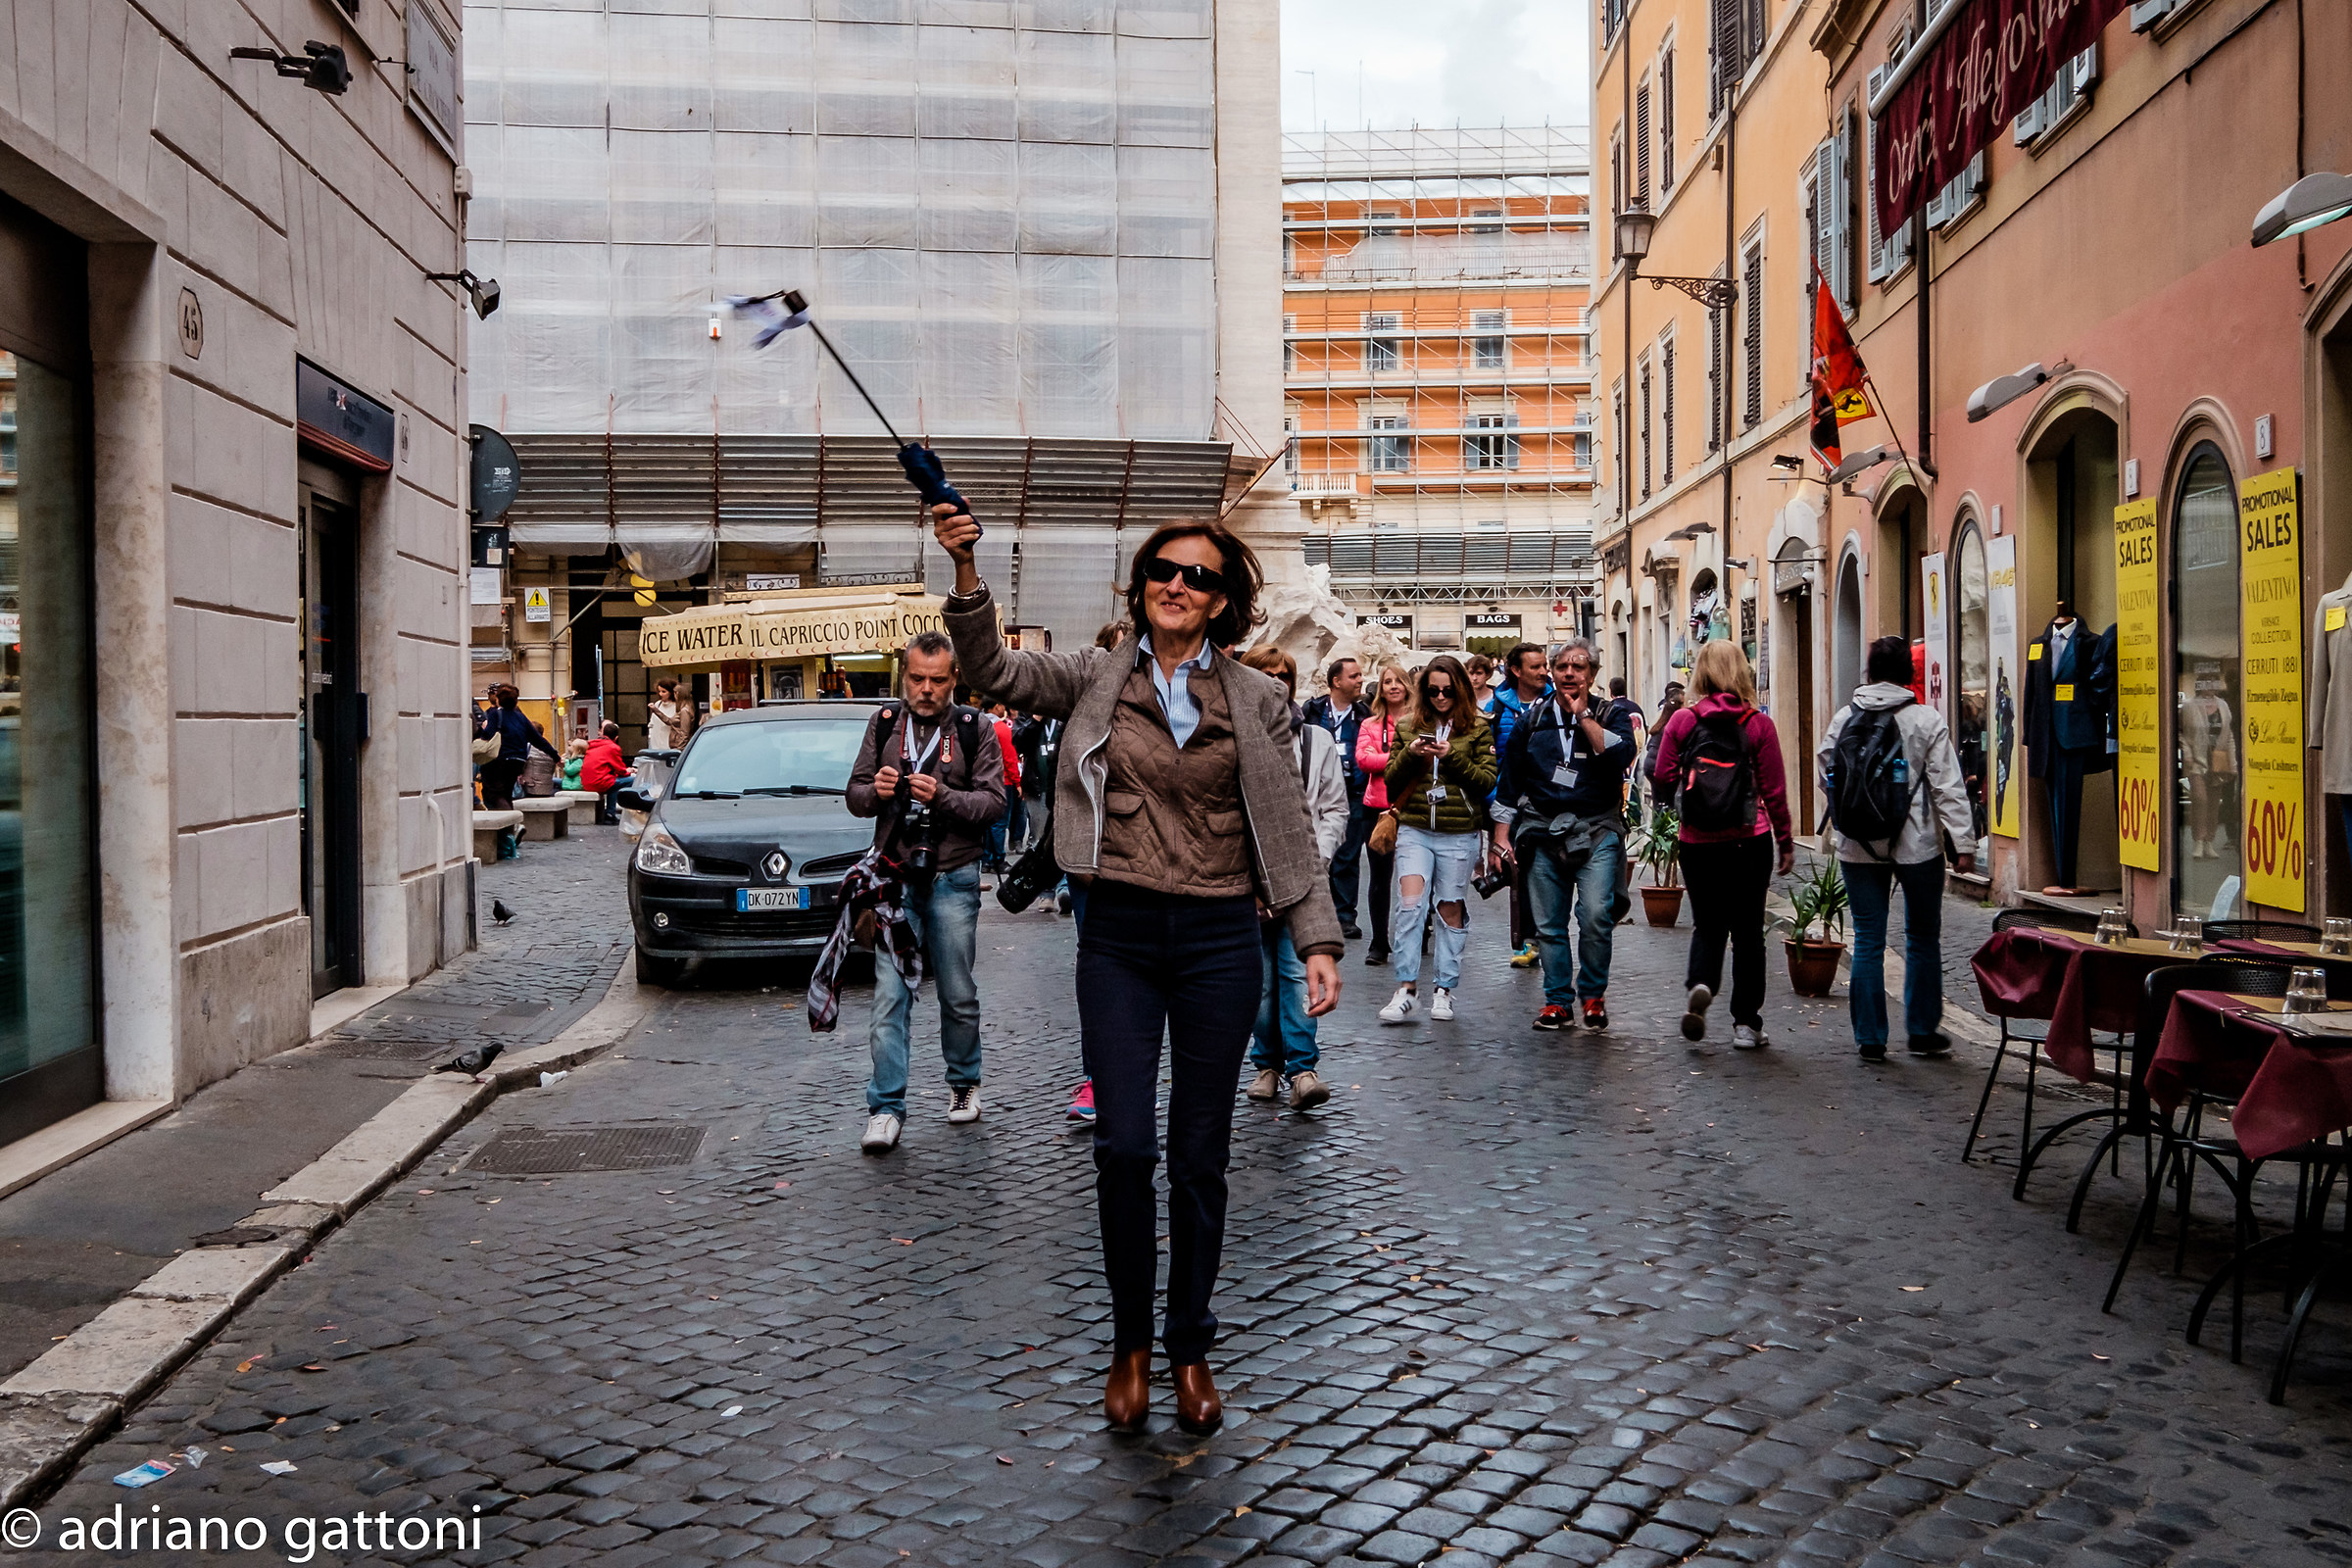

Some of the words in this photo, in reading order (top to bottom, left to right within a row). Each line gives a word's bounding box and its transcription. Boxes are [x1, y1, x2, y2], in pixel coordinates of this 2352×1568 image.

[183, 305, 198, 341] 45
[2242, 486, 2294, 514] PROMOTIONAL
[2116, 513, 2155, 533] PROMOTIONAL
[2247, 513, 2291, 552] SALES
[2119, 535, 2153, 567] SALES
[2245, 576, 2296, 604] VALENTINO
[751, 628, 764, 648] IL
[768, 622, 850, 647] CAPRICCIO
[855, 618, 898, 640] POINT
[1365, 614, 1403, 625] SHOES
[1477, 614, 1510, 624] BAGS
[642, 631, 670, 655] ICE
[677, 623, 744, 652] WATER
[2123, 634, 2151, 646] COLLECTION
[2251, 629, 2291, 645] COLLECTION
[2120, 657, 2142, 672] CERRUTI
[2145, 656, 2156, 671] 1881
[2246, 658, 2278, 675] CERRUTI
[2282, 656, 2298, 673] 1881
[2120, 776, 2157, 846] 60%
[2247, 798, 2302, 881] 60%
[748, 893, 761, 906] DK
